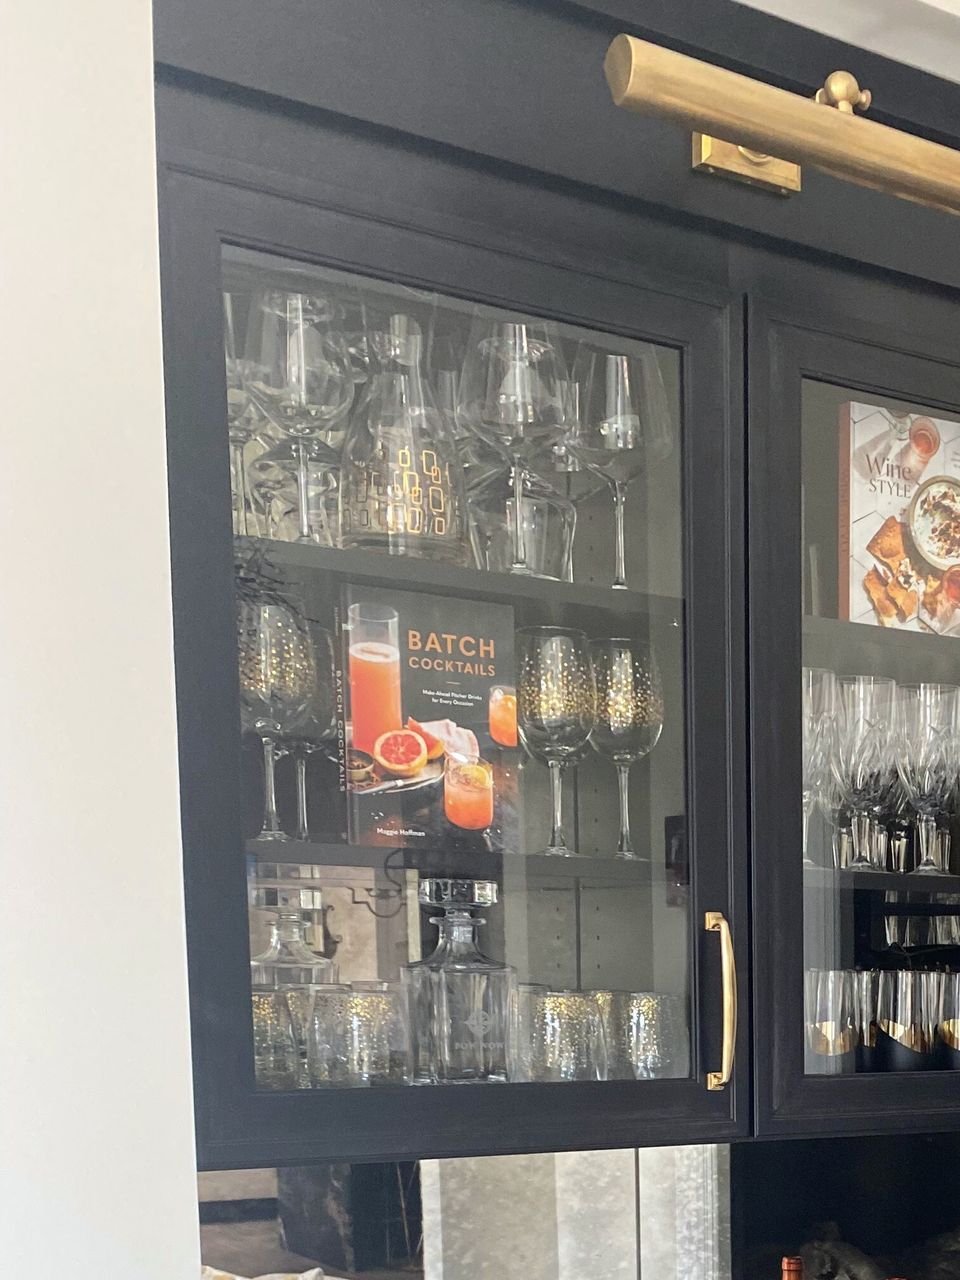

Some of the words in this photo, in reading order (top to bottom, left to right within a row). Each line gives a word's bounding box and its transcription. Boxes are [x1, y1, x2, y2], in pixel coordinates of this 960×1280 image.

[866, 454, 912, 481] Wine
[869, 479, 911, 498] STYLE
[408, 630, 495, 658] BATCH
[409, 656, 496, 676] COCKTAILS
[335, 670, 343, 713] BATCH
[337, 720, 346, 792] COCKTAILS
[376, 827, 399, 837] Maggie
[399, 828, 426, 837] Hoffman
